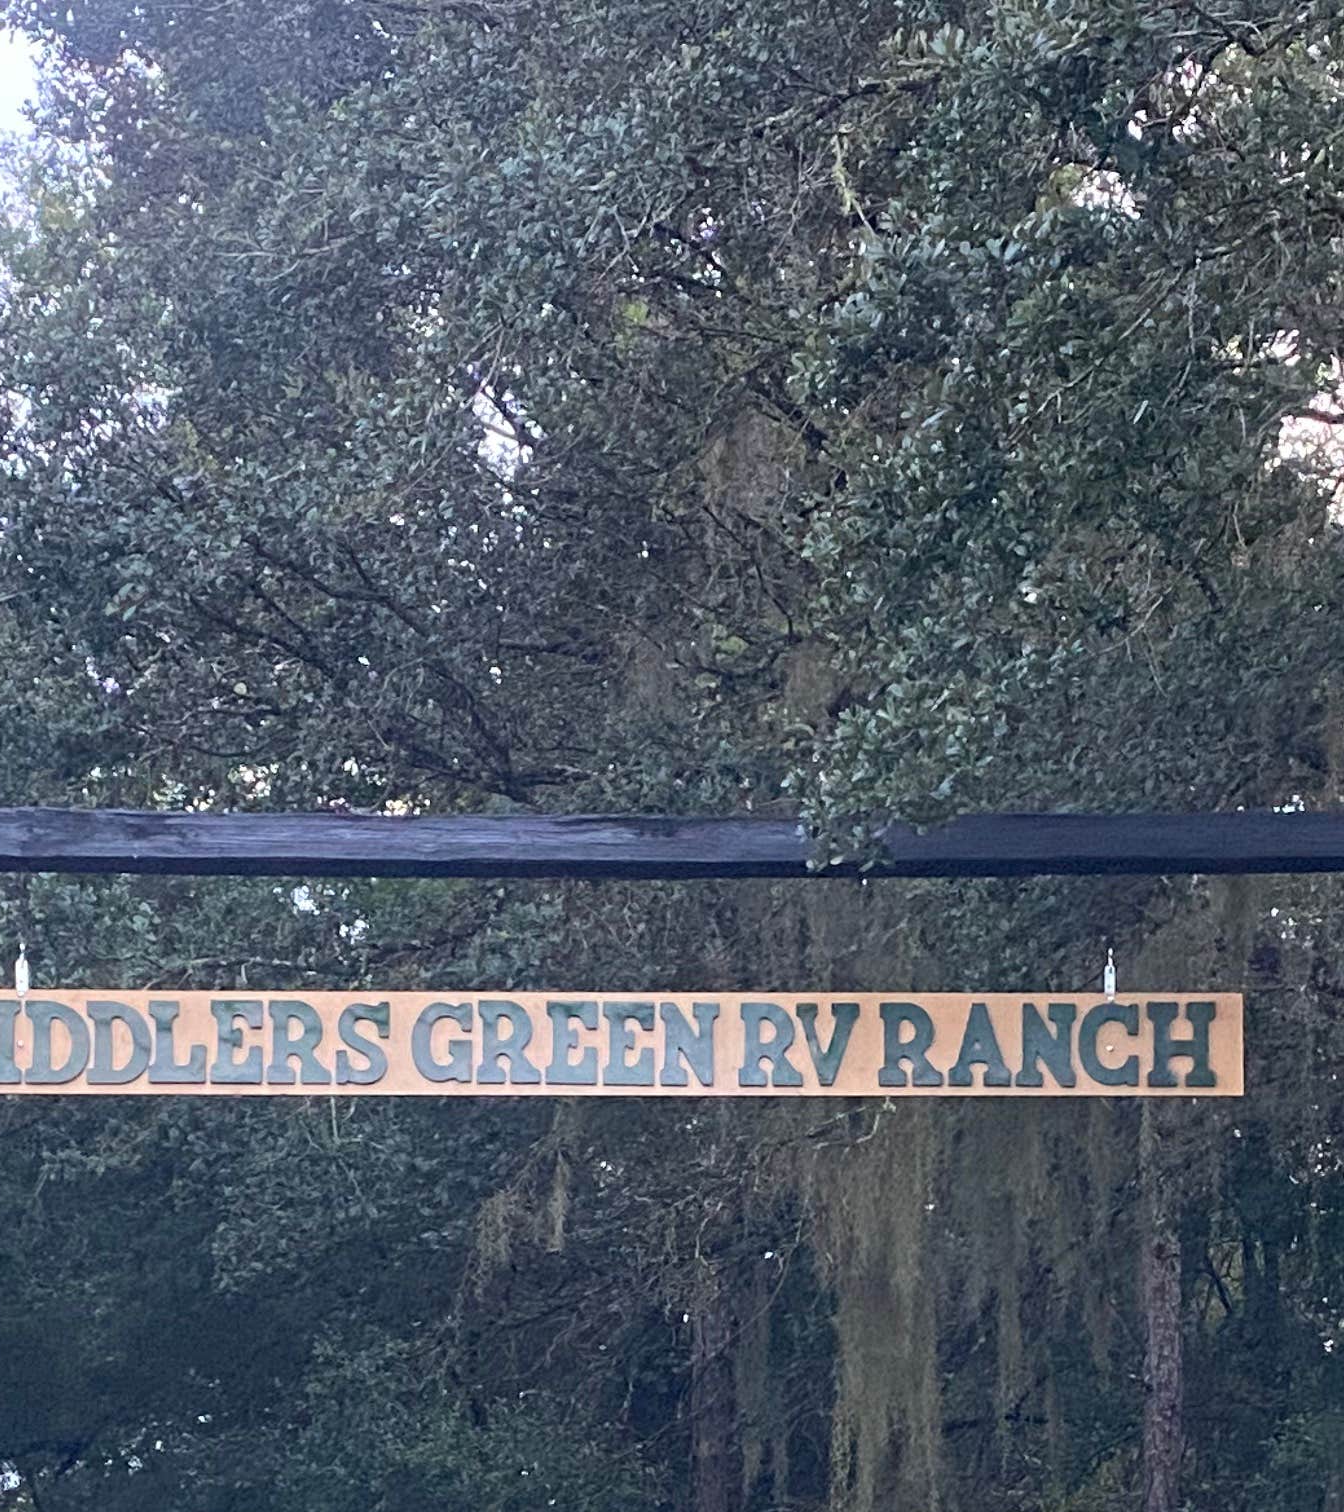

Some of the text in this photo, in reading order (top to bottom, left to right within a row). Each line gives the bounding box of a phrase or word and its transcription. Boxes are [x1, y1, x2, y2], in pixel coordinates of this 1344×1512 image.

[410, 1001, 721, 1086] GREEN
[737, 1002, 860, 1087] RV
[877, 1002, 1218, 1088] RANCH
